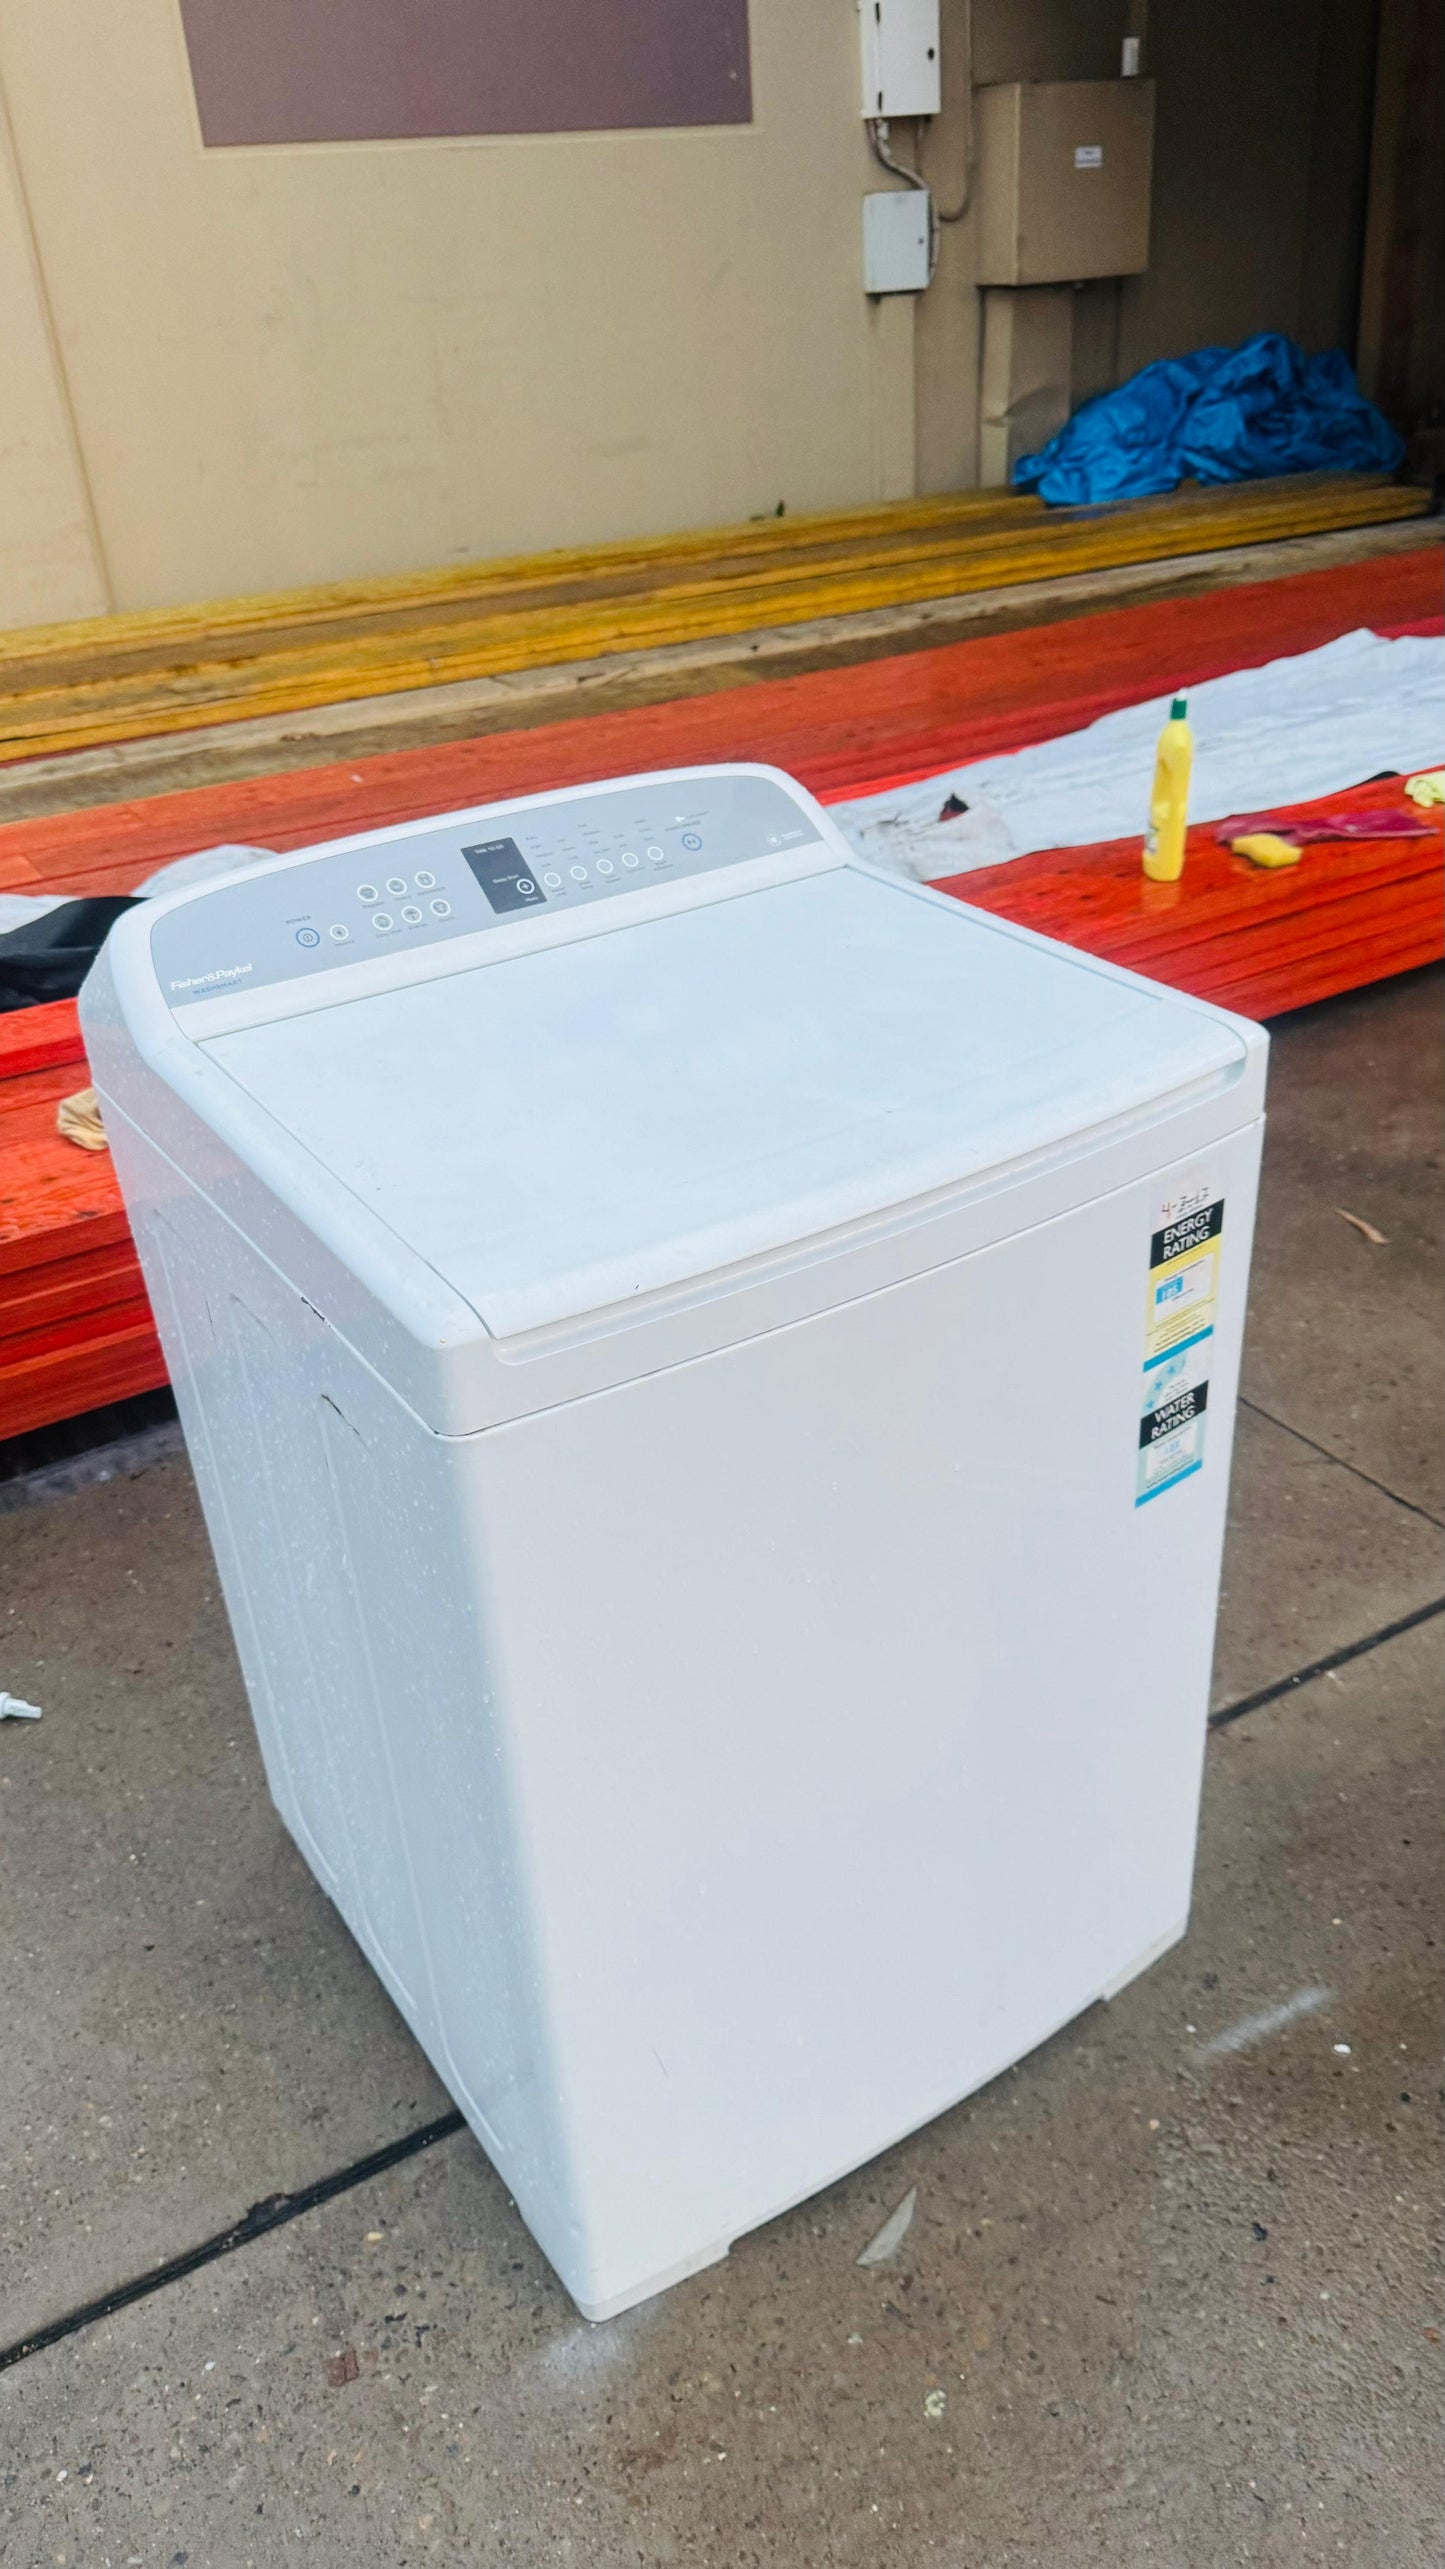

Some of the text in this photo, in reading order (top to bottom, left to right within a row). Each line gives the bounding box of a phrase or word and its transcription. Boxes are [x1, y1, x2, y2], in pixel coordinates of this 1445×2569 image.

[285, 914, 312, 925] POWER
[1162, 1226, 1211, 1260] RATING
[1163, 1207, 1214, 1245] ENERGY
[1151, 1405, 1196, 1439] RATING
[1154, 1392, 1196, 1423] WATER
